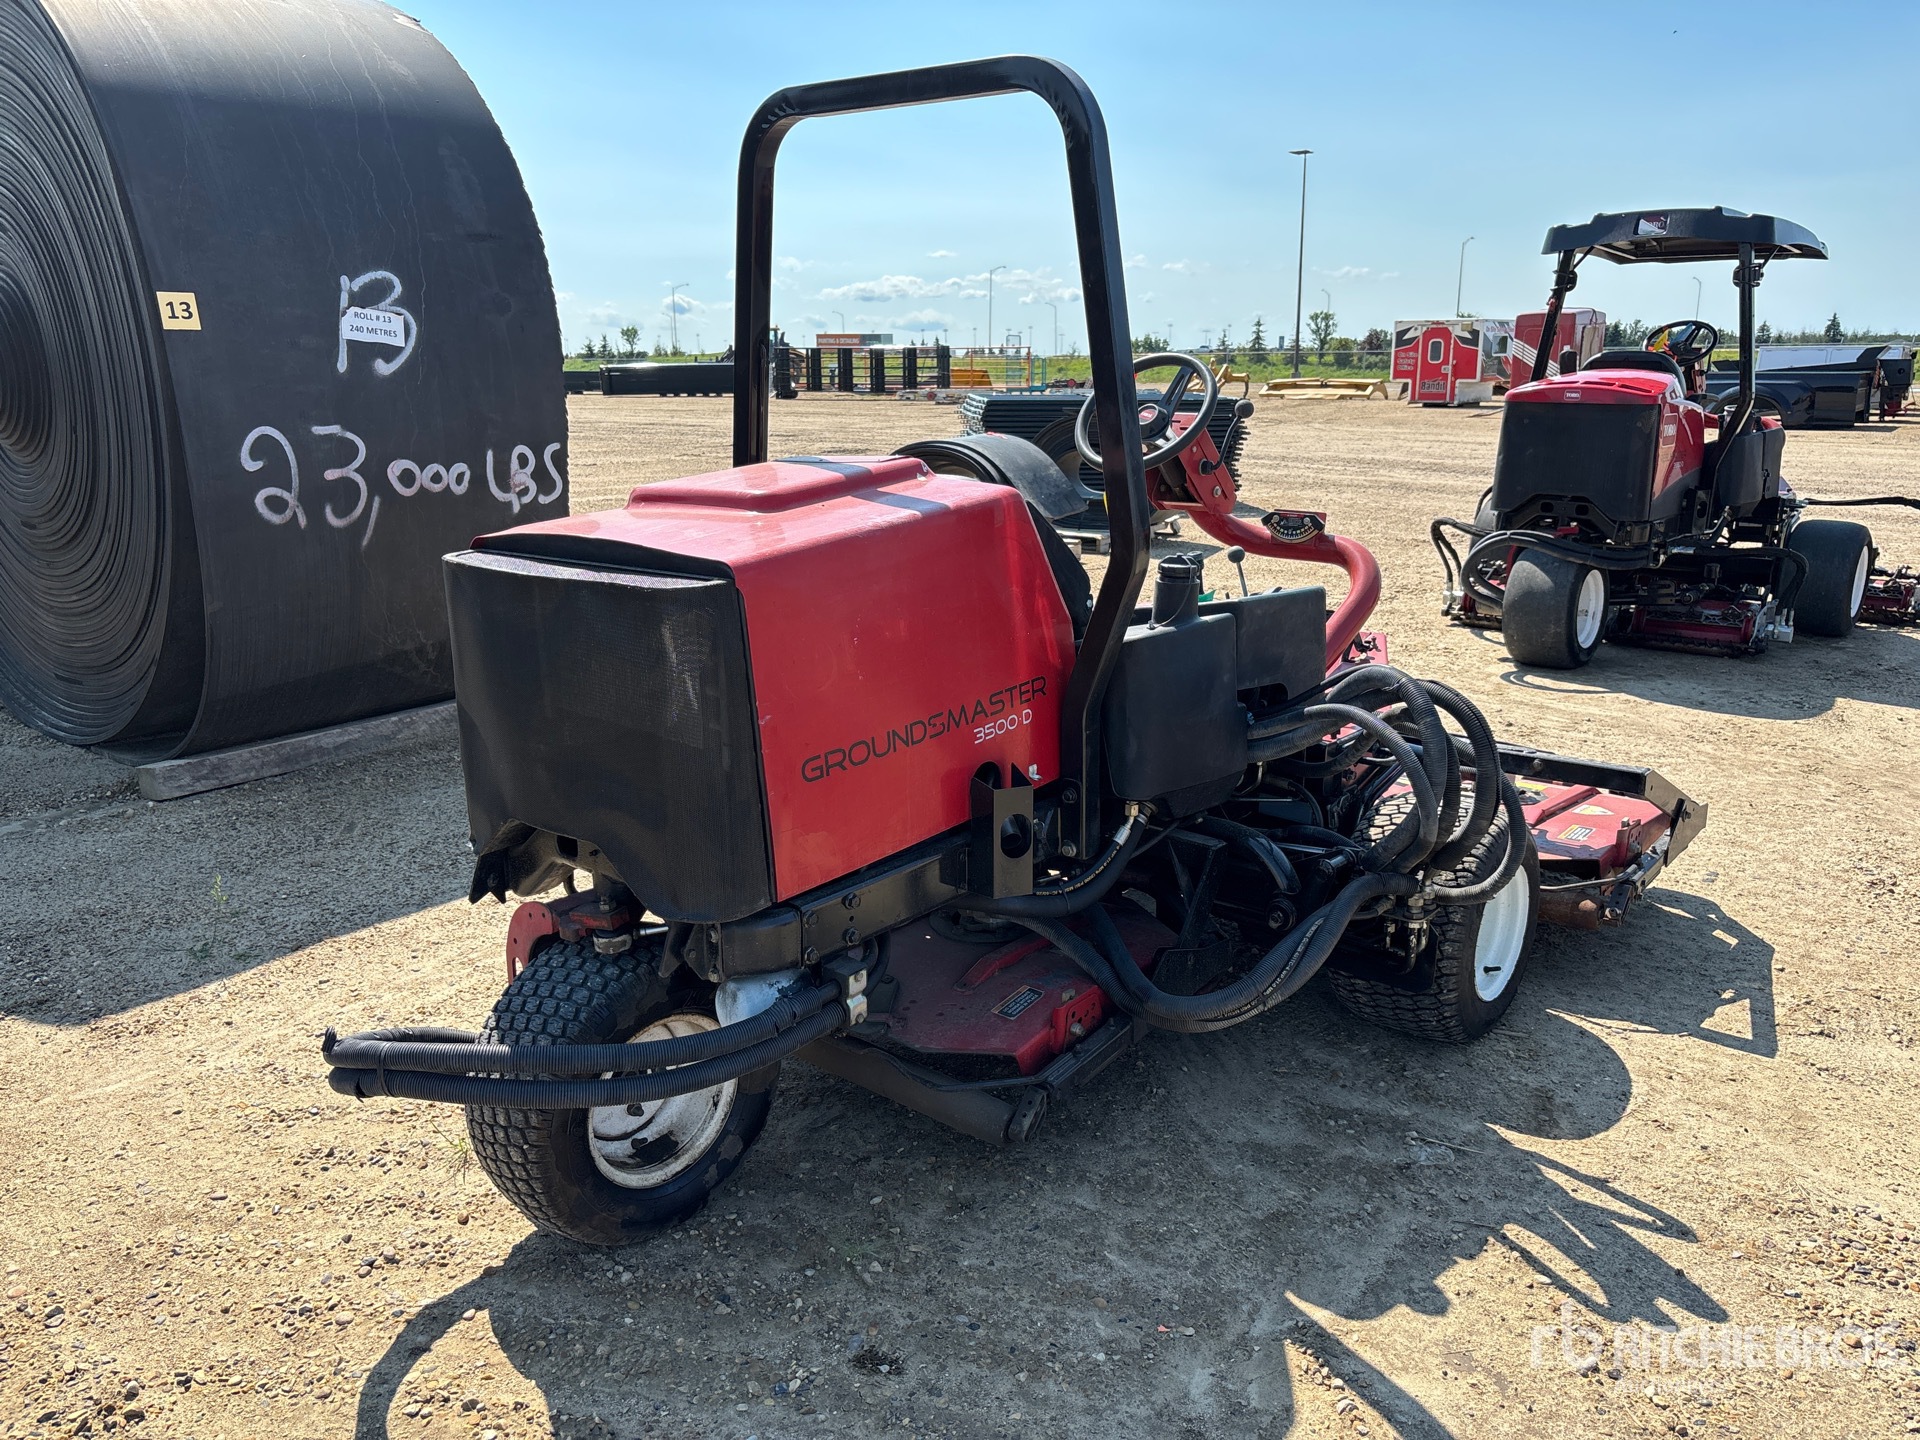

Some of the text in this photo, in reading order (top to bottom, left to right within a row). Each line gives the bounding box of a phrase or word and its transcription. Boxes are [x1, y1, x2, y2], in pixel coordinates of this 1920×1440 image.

[165, 301, 194, 320] 13
[353, 311, 374, 322] ROLL
[382, 315, 392, 324] 13
[337, 270, 418, 375] B
[349, 324, 398, 338] 240 METRES
[1421, 381, 1446, 391] Bandit
[486, 442, 564, 514] LBS
[801, 675, 1048, 783] GROUNDSMASTER
